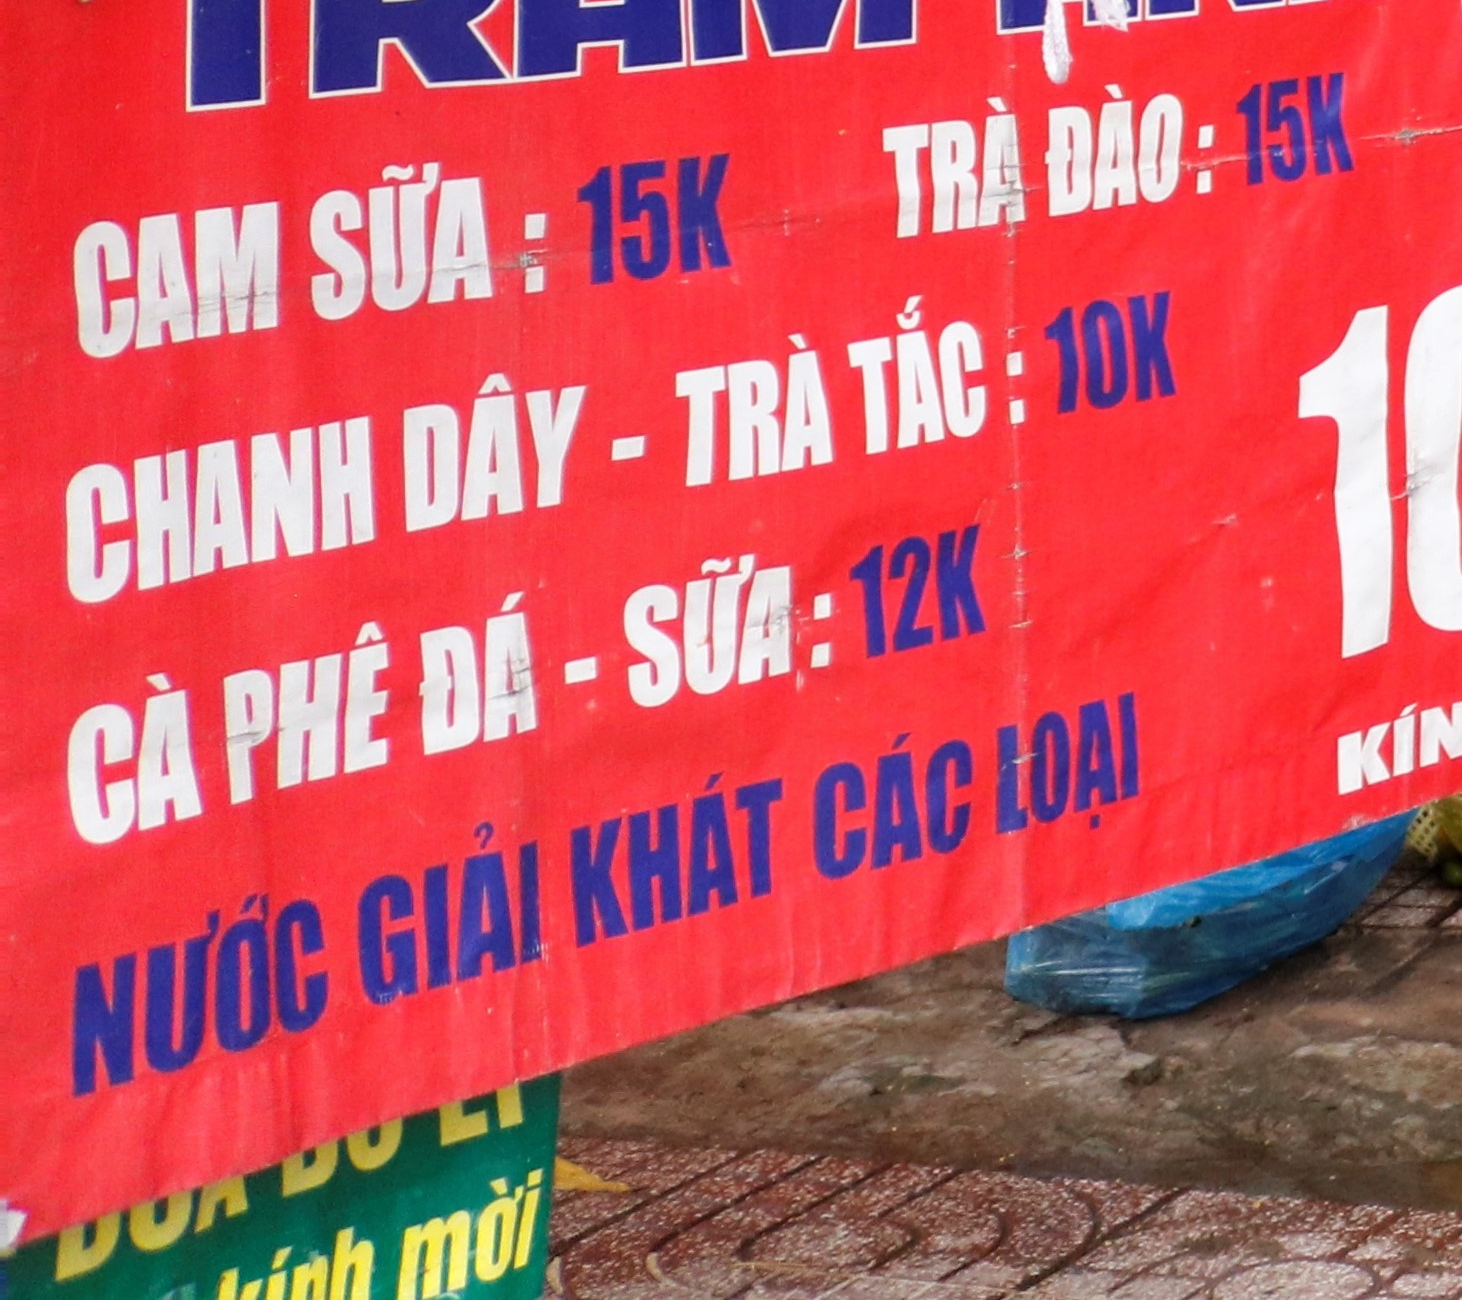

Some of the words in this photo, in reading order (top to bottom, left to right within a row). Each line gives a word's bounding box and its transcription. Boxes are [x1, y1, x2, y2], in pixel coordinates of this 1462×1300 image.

[73, 201, 280, 359] CAM
[309, 162, 493, 321] SỮA
[577, 153, 733, 285] 15K
[883, 96, 1025, 239] TRÀ
[1045, 83, 1184, 218] ĐÀO
[1236, 71, 1355, 186] 15K
[65, 416, 377, 604] CHANH
[404, 373, 588, 533] DÂY
[675, 334, 834, 487] TRÀ
[847, 294, 986, 455] TẮC
[1044, 290, 1177, 415] 10K
[68, 675, 203, 845] CÀ
[223, 622, 390, 805] PHÊ
[419, 592, 539, 756] ĐÁ
[623, 554, 793, 708] SỮA
[848, 524, 987, 659] 12K
[73, 893, 329, 1098] NƯỚC
[358, 821, 542, 1006] GIẢI
[570, 772, 783, 949] KHÁT
[813, 732, 973, 881] CÁC
[995, 690, 1141, 835] LOẠI
